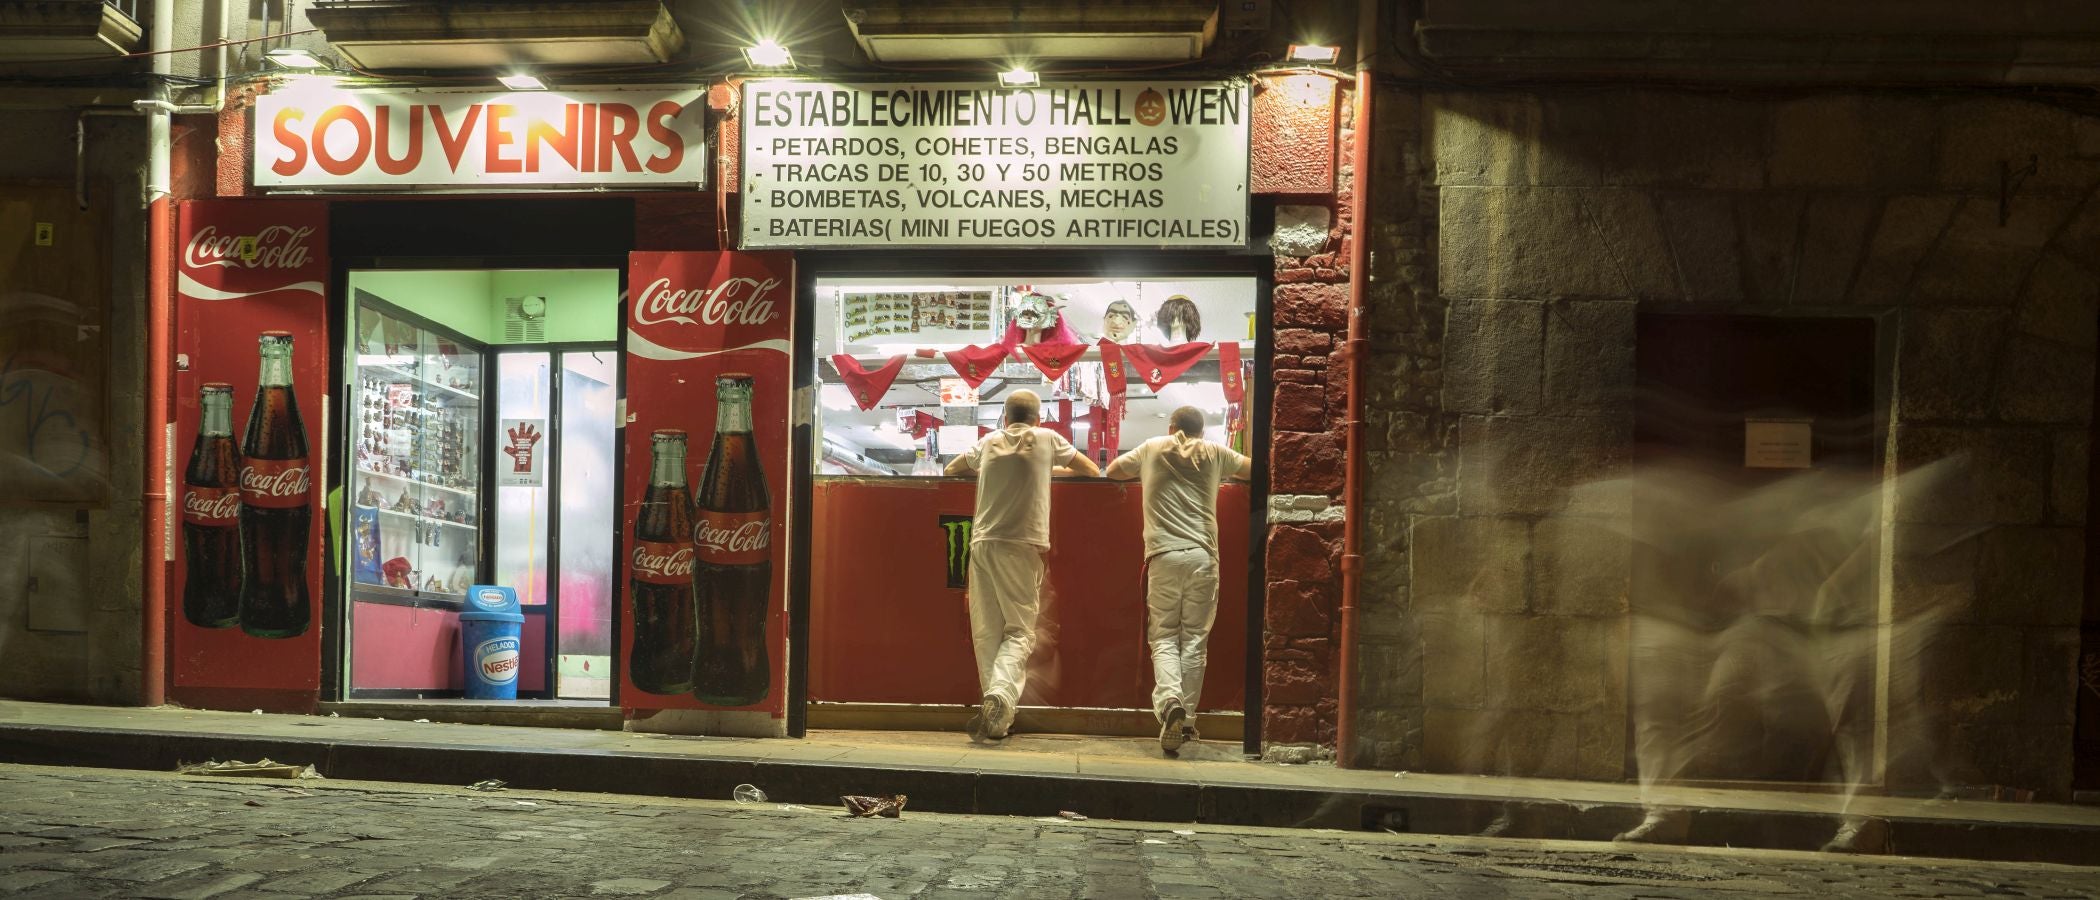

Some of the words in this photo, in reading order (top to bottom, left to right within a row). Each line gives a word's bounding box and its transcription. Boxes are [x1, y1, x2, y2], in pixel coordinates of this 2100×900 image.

[755, 89, 1036, 127] ESTABLECIMIENTO
[271, 100, 685, 177] SOUVENIRS
[772, 137, 906, 159] PETARDOS,
[915, 137, 1035, 159] COHETES,
[1045, 136, 1178, 155] BENGALAS
[772, 163, 869, 182] TRACAS
[878, 163, 909, 182] DE
[919, 163, 948, 186] 10,
[957, 163, 985, 182] 30
[996, 163, 1012, 182] Y
[1022, 163, 1050, 182] 50
[1060, 162, 1163, 182] METROS
[770, 189, 906, 212] BOMBETAS,
[916, 189, 1051, 212] VOLCANES,
[1060, 189, 1164, 208] MECHAS
[769, 218, 892, 242] BATERIAS(
[901, 218, 948, 238] MINI
[958, 218, 1056, 238] FUEGOS
[1066, 219, 1240, 243] ARTIFICIALES)
[185, 225, 317, 269] CocaCola
[634, 277, 784, 326] Coca-Cola
[240, 464, 311, 498] Coca-Cola
[184, 491, 240, 520] Coca-Col
[694, 517, 770, 554] Coca-Cola
[632, 546, 694, 577] Coca-Col
[486, 641, 516, 654] HELADOS
